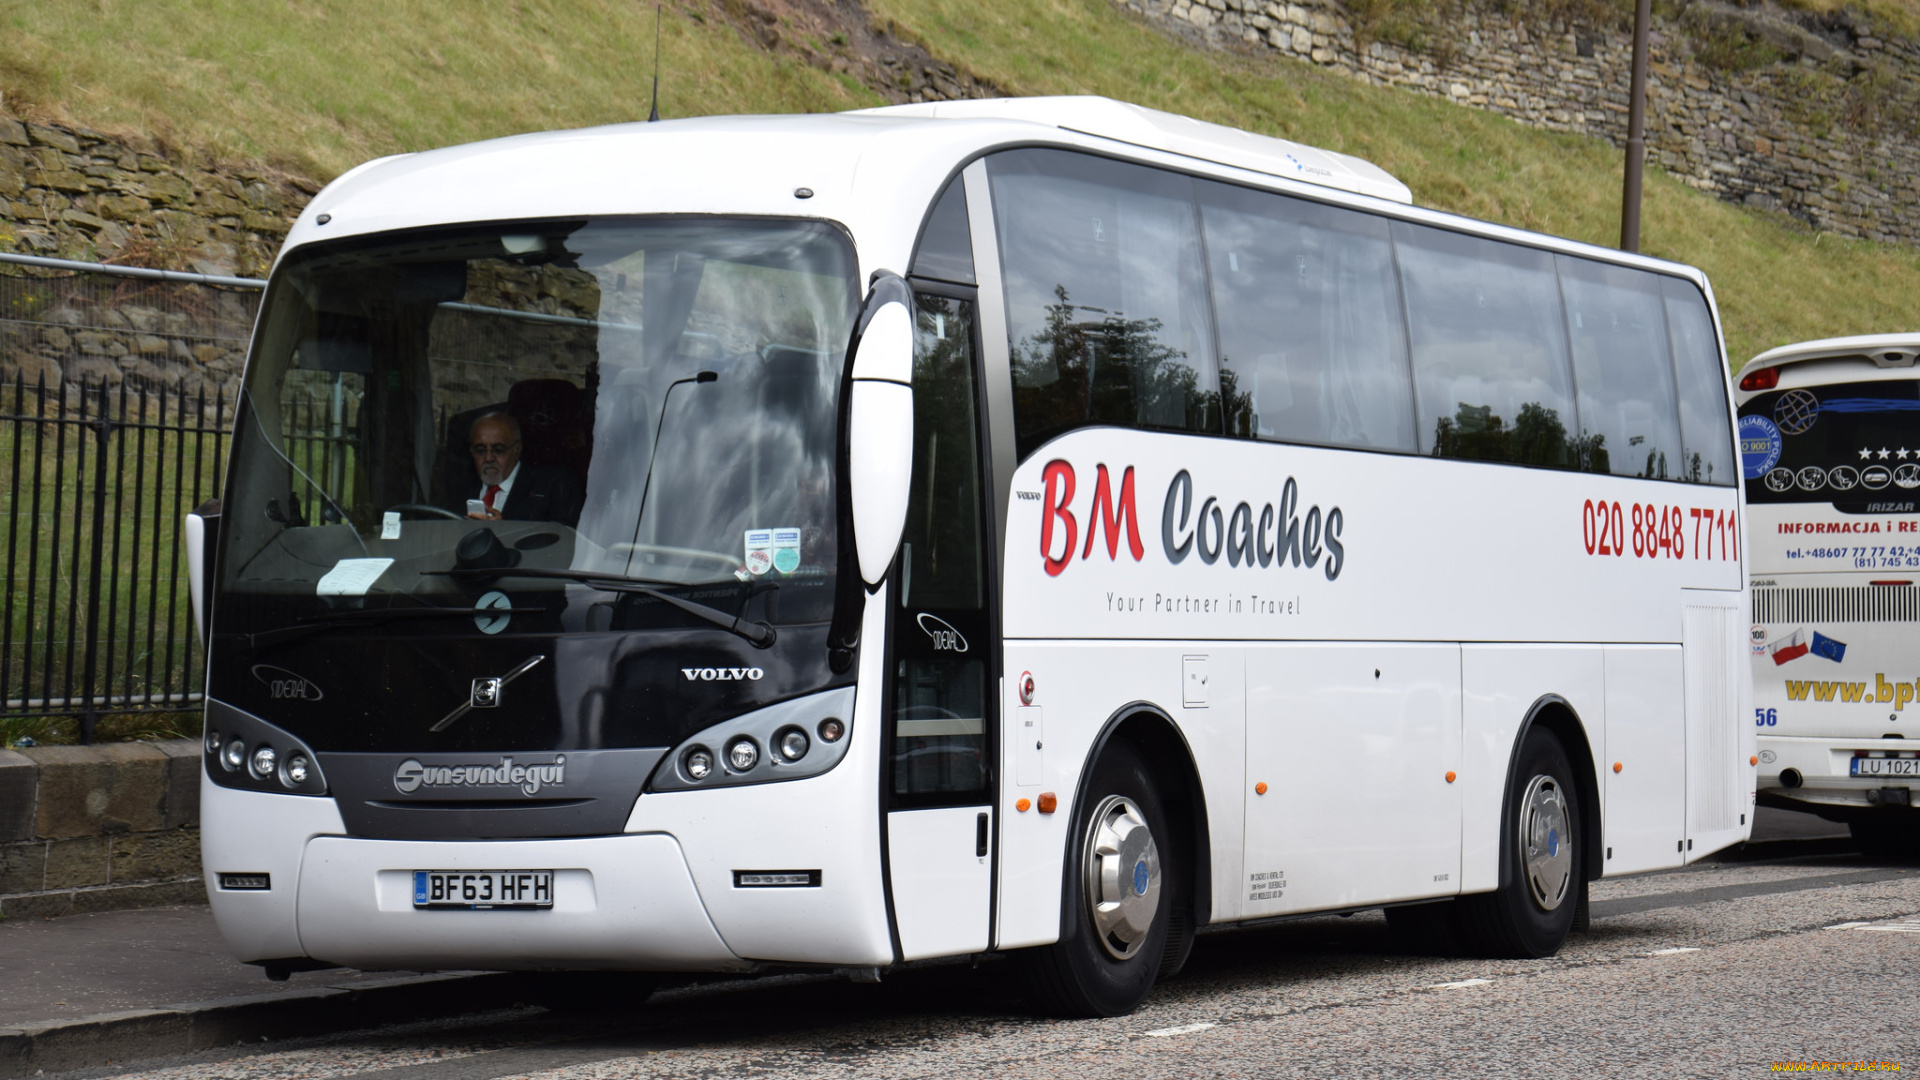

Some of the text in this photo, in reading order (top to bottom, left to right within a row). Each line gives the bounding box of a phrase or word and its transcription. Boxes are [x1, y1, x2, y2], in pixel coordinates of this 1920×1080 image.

[1738, 417, 1780, 475] ELIABILITY POLSKA
[1751, 441, 1770, 451] 9001
[1866, 502, 1915, 512] IRIZAR
[1040, 458, 1345, 582] BM Coaches
[1778, 522, 1880, 534] INFORMACJA
[1887, 520, 1892, 532] i
[1583, 499, 1737, 562] 020 8848 7711
[1786, 547, 1848, 559] tel.+48607
[1852, 547, 1867, 557] 77
[1871, 546, 1886, 557] 77
[1854, 556, 1919, 568] (81) 745 43
[1107, 592, 1301, 615] Your Partner in Travel
[1751, 630, 1764, 640] 100
[682, 667, 764, 681] VOLVO
[270, 679, 308, 700] SIDERAL
[1755, 708, 1777, 727] 56
[394, 754, 567, 797] Sunsundegui
[1861, 760, 1881, 774] LU
[1887, 760, 1919, 775] 1021
[430, 875, 549, 900] BF63 HFH
